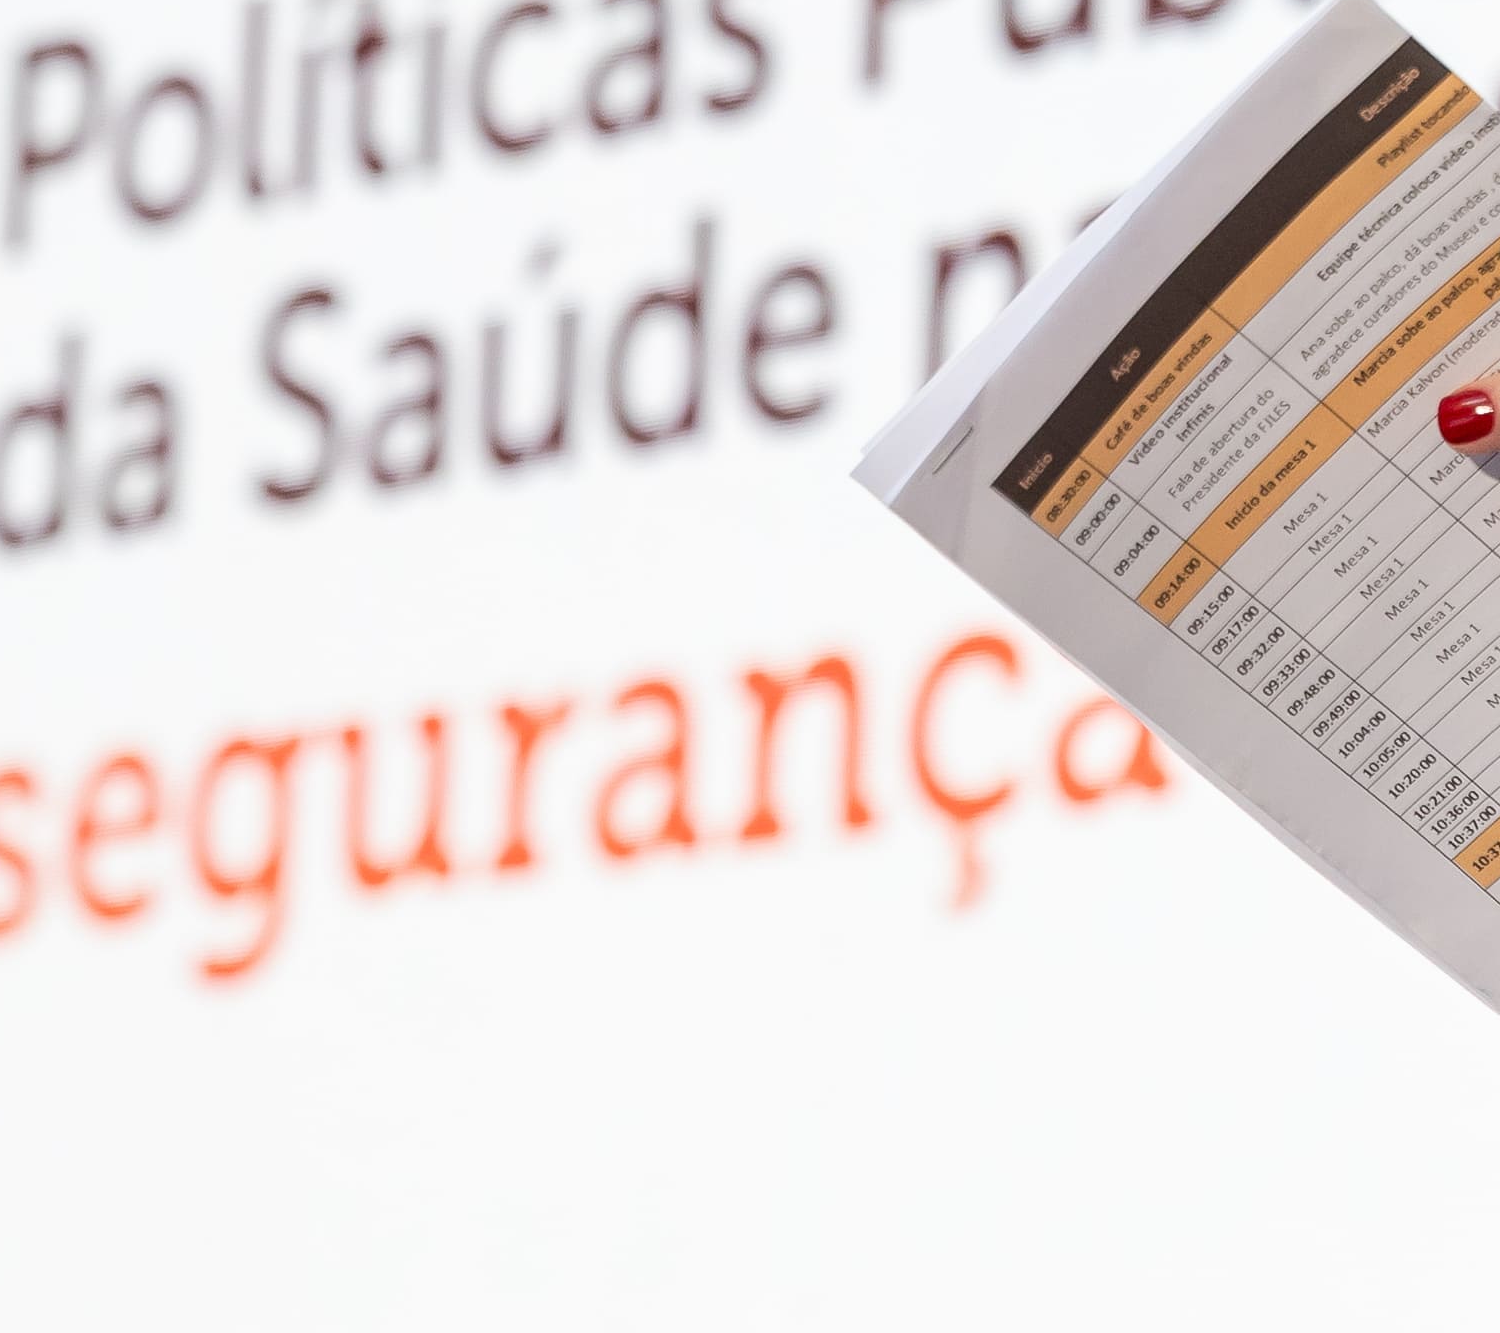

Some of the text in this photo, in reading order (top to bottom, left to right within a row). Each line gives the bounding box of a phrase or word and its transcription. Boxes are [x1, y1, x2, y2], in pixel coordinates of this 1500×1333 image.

[1316, 241, 1361, 282] Equipe
[1357, 202, 1404, 243] técnica
[1401, 169, 1442, 205] coloca
[1300, 336, 1327, 363] Ana
[1323, 308, 1355, 338] sobe
[1353, 292, 1371, 310] ao
[1416, 221, 1451, 248] boas
[1447, 188, 1489, 223] vindas
[1311, 327, 1365, 381] agradece
[1362, 274, 1422, 330] curadores
[1419, 259, 1439, 277] do
[1434, 223, 1480, 262] Museu
[1478, 216, 1490, 227] e
[252, 208, 840, 508] Saúde
[1352, 346, 1398, 388] Marcia
[1395, 319, 1427, 349] sobe
[1424, 304, 1443, 322] ao
[1105, 332, 1213, 451] Café de boas vindas
[1160, 352, 1234, 430] institucional
[1366, 398, 1410, 439] Marcia
[1405, 361, 1450, 400] Kalvon
[1167, 389, 1275, 499] Fala de abertura do
[1175, 403, 1216, 443] Infinis
[1181, 448, 1245, 513] Presidente
[1243, 432, 1261, 450] da
[1258, 479, 1277, 498] da
[1274, 448, 1309, 483] mesa
[1304, 439, 1317, 451] 1
[1428, 446, 1469, 486] Marci
[1075, 492, 1122, 547] 09:00:00
[1282, 492, 1329, 535] Mesa 1
[1307, 513, 1354, 556] Mesa 1
[1113, 524, 1161, 577] 09:04:00
[1333, 535, 1380, 578] Mesa 1
[1153, 556, 1202, 610] 09:14:00
[1358, 557, 1405, 601] Mesa 1
[1383, 578, 1430, 621] Mesa 1
[1186, 584, 1236, 636] 09:15:00
[1211, 605, 1260, 656] 09:17:00
[1409, 600, 1457, 643] Mesa 1
[1236, 625, 1286, 677] 09:32:00
[1435, 623, 1482, 665] Mesa 1
[1262, 647, 1312, 697] 09:33:00
[1286, 668, 1336, 717] 09:48:00
[1459, 654, 1498, 687] Mesa
[1311, 689, 1361, 738] 09:49:00
[1338, 710, 1387, 760] 10:04:00
[1362, 730, 1412, 779] 10:05:00
[1388, 753, 1438, 800] 10:20:00
[1413, 775, 1463, 822] 10:21:00
[1430, 789, 1480, 836] 10:36:00
[1447, 805, 1498, 851] 10:37:00
